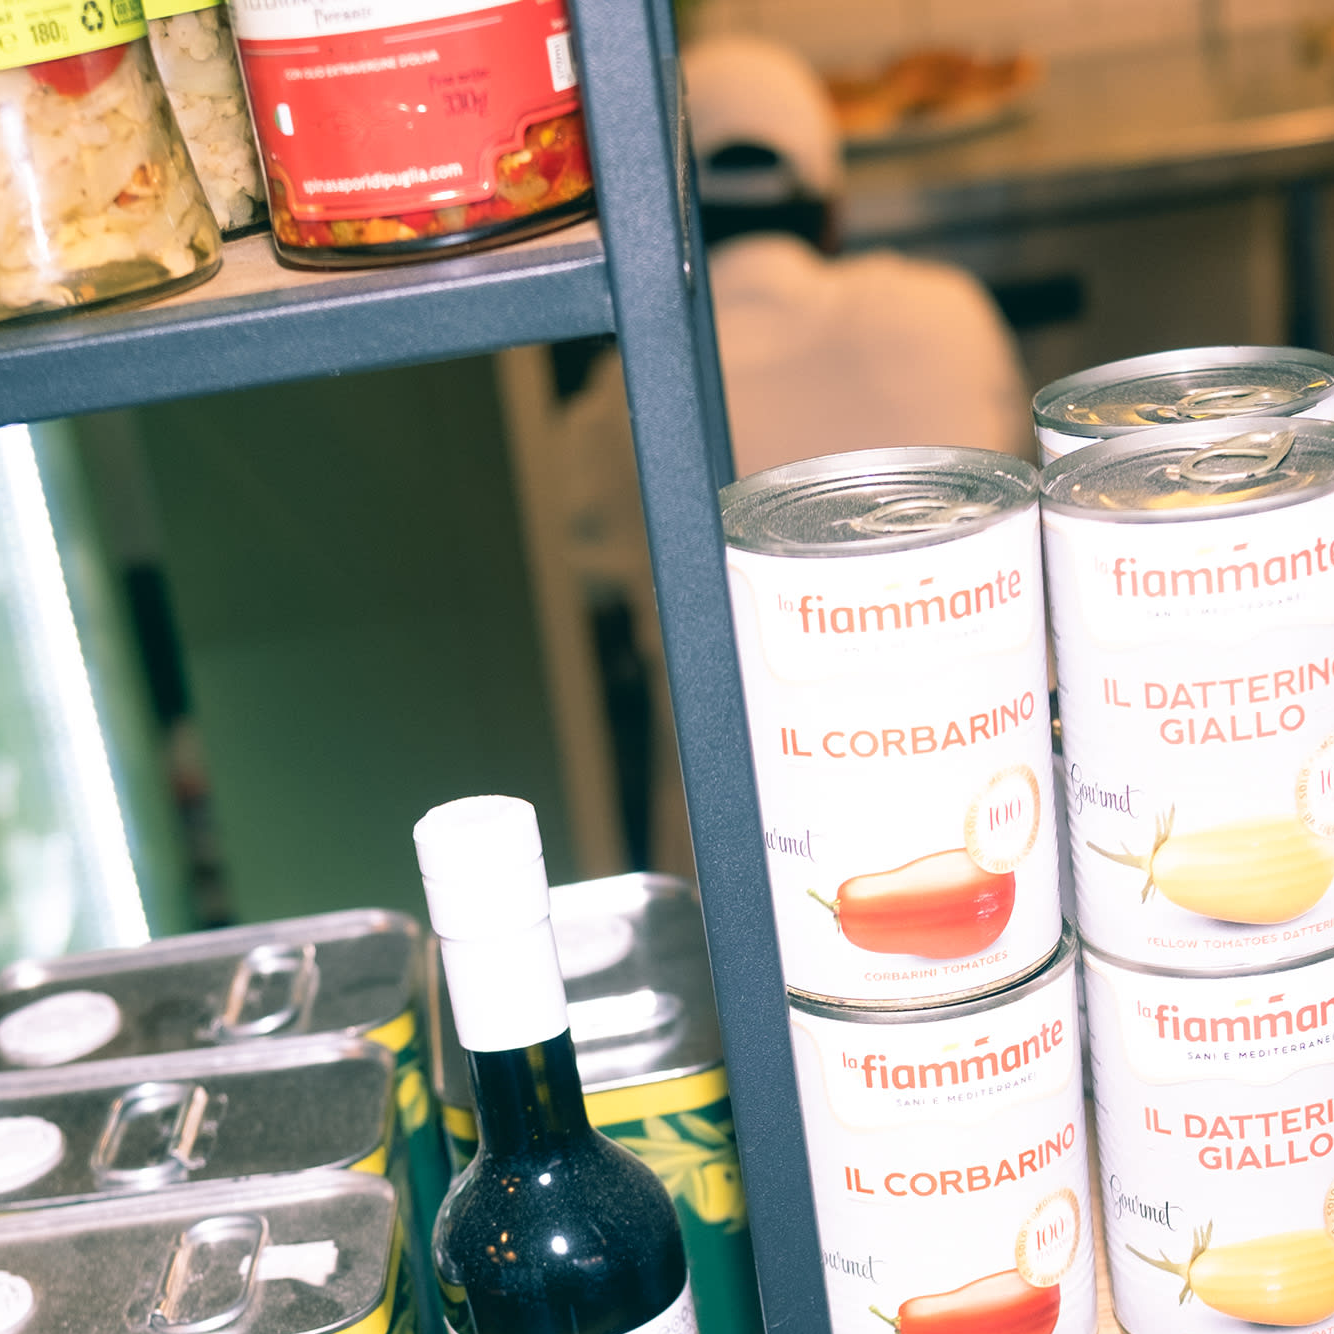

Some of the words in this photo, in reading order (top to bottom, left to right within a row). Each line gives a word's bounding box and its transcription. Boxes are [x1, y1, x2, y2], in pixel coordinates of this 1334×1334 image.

[798, 568, 1022, 635] fiammante
[1103, 677, 1132, 708] IL
[780, 727, 812, 758] IL
[822, 690, 1036, 760] CORBARINO
[1159, 703, 1306, 746] GIALLO
[1070, 762, 1144, 820] Gourmet
[1147, 935, 1200, 951] YELLOW
[1203, 933, 1279, 951] TOMATOES
[864, 964, 938, 983] CORBARINI
[942, 949, 1008, 976] TOMATOES
[861, 1019, 1064, 1090] fiammante
[1187, 1050, 1217, 1062] SANI
[1144, 1106, 1172, 1136] IL
[844, 1166, 874, 1195] IL
[884, 1122, 1076, 1197] CORBARINO
[1198, 1132, 1334, 1172] GIALLO
[1109, 1174, 1184, 1232] Gourmet
